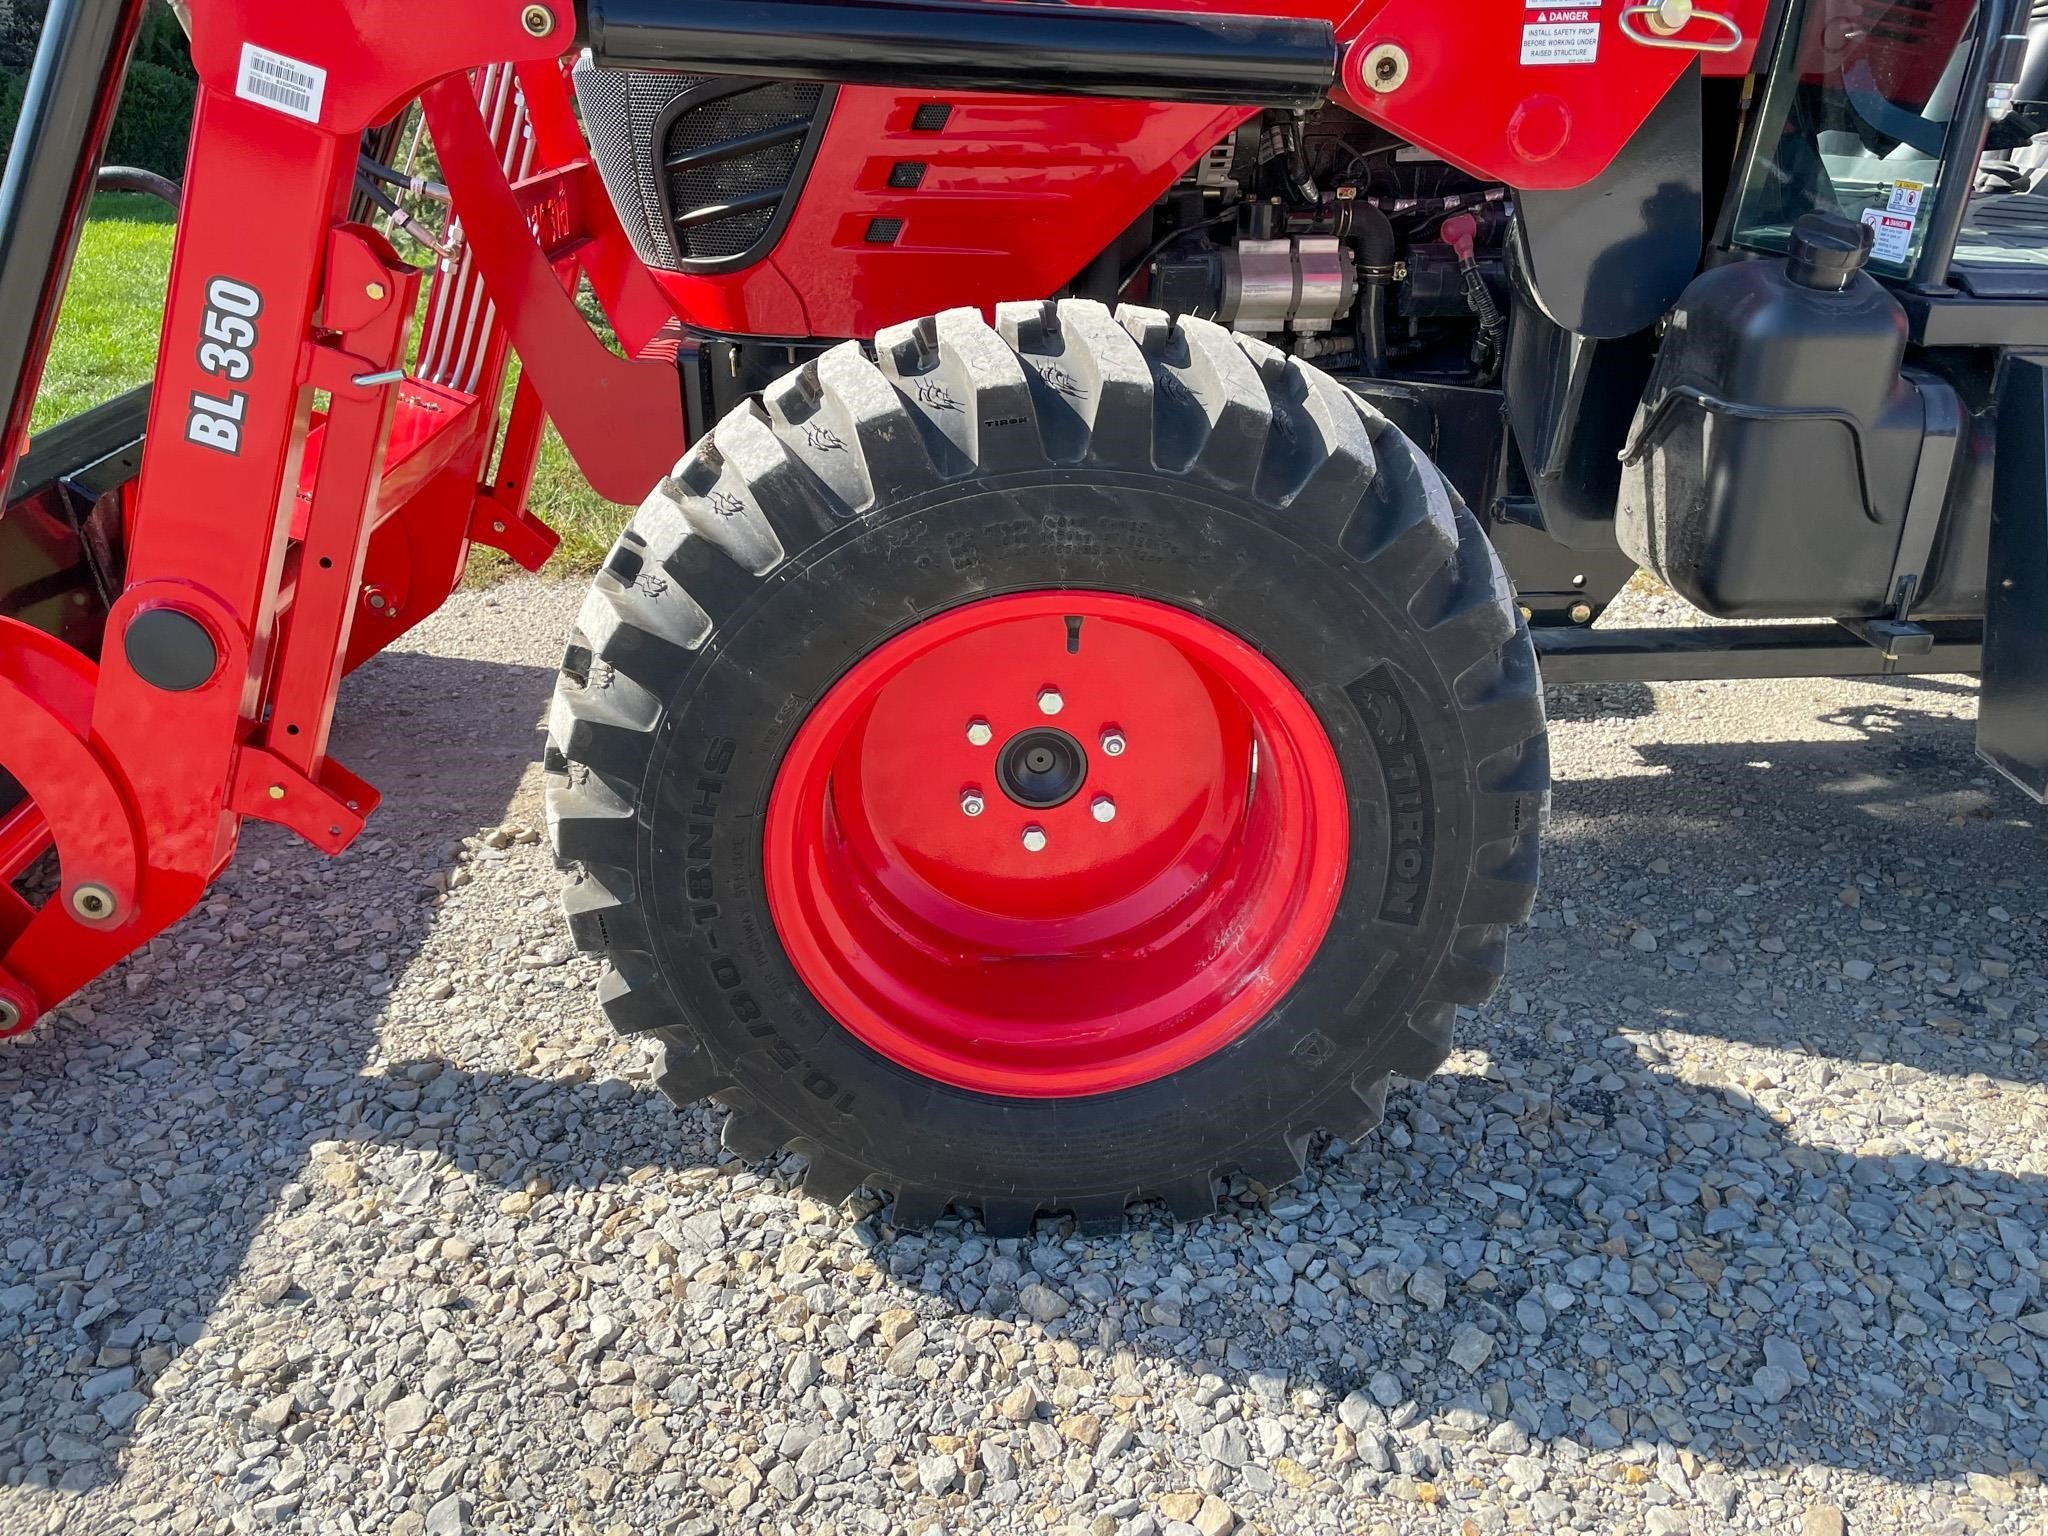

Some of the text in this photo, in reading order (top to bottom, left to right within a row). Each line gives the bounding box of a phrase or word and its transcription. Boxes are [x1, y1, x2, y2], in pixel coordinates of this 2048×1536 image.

[1549, 11, 1589, 21] DANGER
[1553, 28, 1576, 36] SAFETY
[1530, 49, 1552, 57] RAISED
[186, 276, 263, 455] BL 350
[984, 416, 1029, 428] TIRON
[1386, 752, 1424, 914] TIRON
